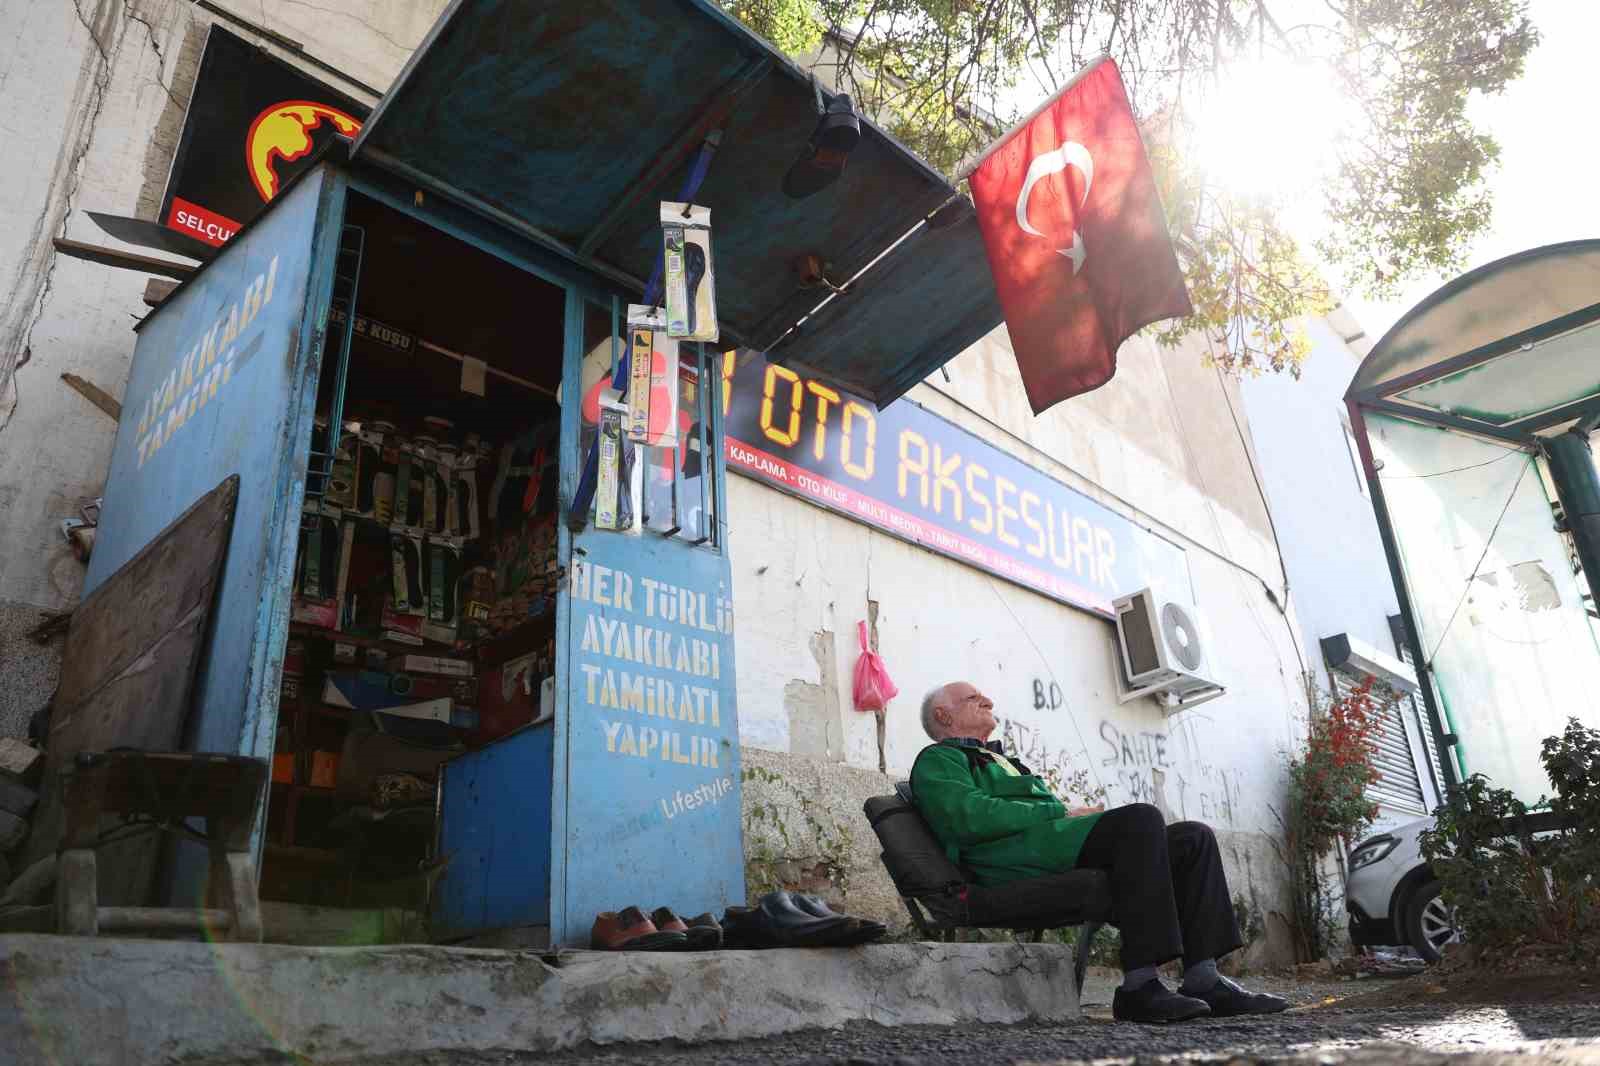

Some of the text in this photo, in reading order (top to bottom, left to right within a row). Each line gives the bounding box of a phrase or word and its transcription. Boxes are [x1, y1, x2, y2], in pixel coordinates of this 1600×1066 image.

[730, 446, 787, 481] KAPLAMA
[798, 475, 820, 493] OTO
[759, 362, 878, 482] OTO
[896, 426, 1121, 596] AKSESUAR
[571, 558, 633, 612] HER
[580, 614, 720, 681] AYAKKABI
[599, 719, 719, 769] YAPILIR
